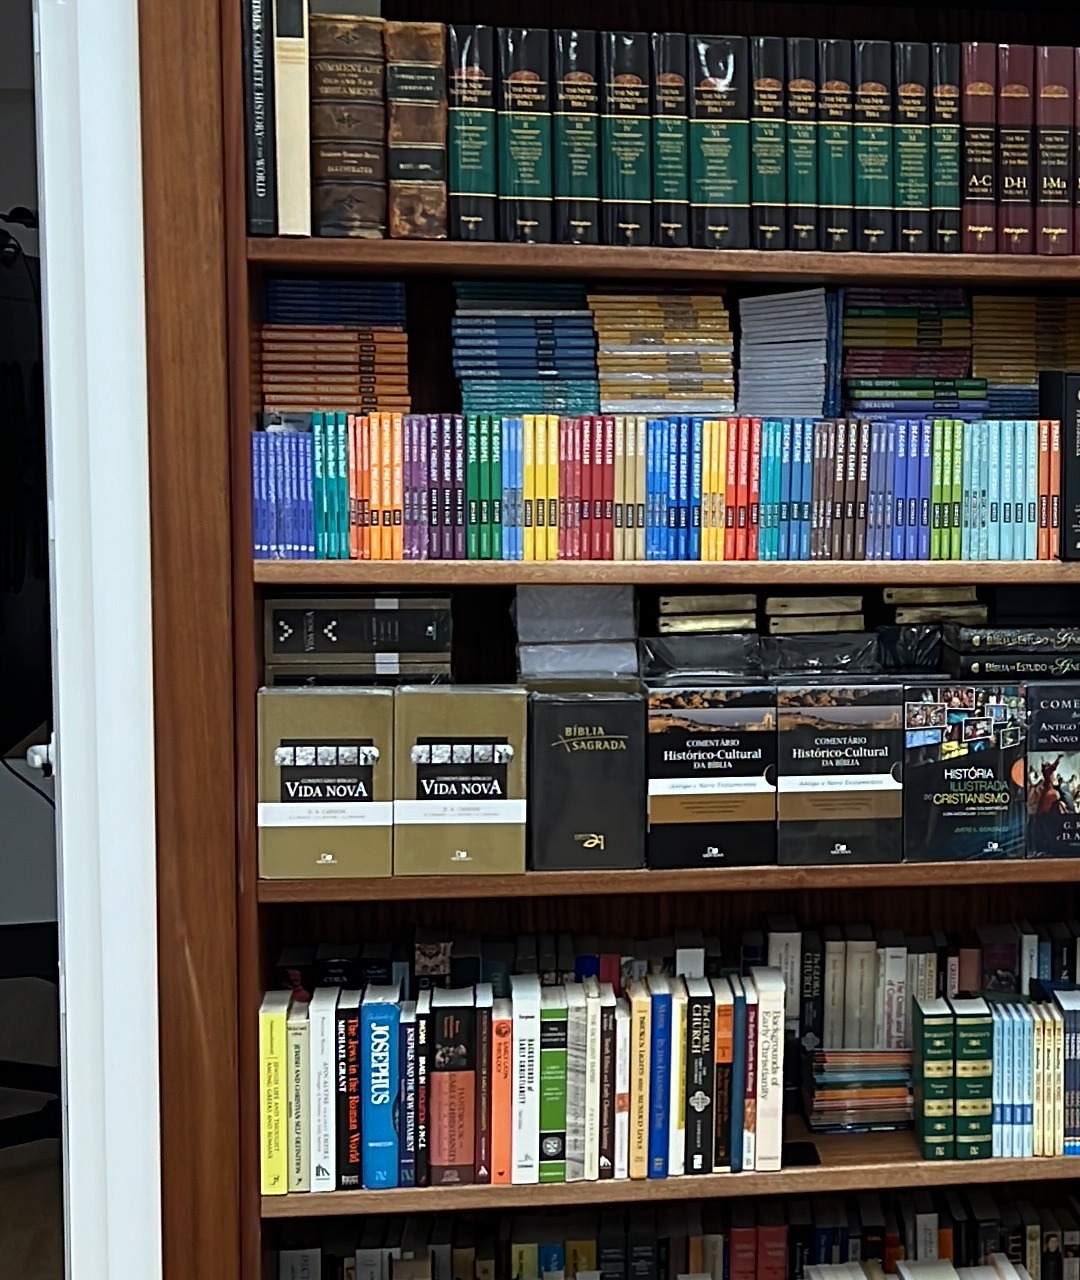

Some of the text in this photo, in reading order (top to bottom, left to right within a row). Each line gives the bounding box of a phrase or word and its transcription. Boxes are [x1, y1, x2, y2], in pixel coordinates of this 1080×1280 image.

[252, 35, 263, 86] COMPLETE
[254, 90, 264, 143] HISTORY
[256, 159, 266, 198] WORLD
[969, 175, 993, 186] A-C
[1005, 177, 1026, 188] D-H
[1043, 177, 1066, 188] I-Ma
[985, 663, 1009, 671] BÍBLIA
[1017, 662, 1047, 671] ESTUDO
[565, 726, 604, 737] BÍBLIA
[1040, 722, 1077, 731] ANTIGO
[572, 740, 626, 751] SAGRADA
[686, 738, 739, 747] COMENTÁRIO
[814, 736, 867, 745] COMENTÁRIO
[1050, 735, 1078, 744] NOVO
[663, 749, 761, 761] Histórico-Cultural
[792, 747, 888, 759] Histórico-Cultural
[693, 760, 732, 769] DA BÍBLIA
[822, 759, 860, 767] DA BÍBLIA
[944, 766, 994, 780] HISTÓRIA
[285, 782, 368, 797] VIDA NOVA
[421, 779, 501, 795] VIDA NOVA
[950, 781, 1008, 791] ILUSTRADA
[933, 792, 1010, 804] CRISTIANISMO
[1062, 832, 1072, 840] D.
[691, 1004, 701, 1054] CHURCH
[702, 1018, 710, 1054] GLOBAL
[770, 1011, 781, 1087] Backgrounds of
[337, 1020, 347, 1092] MICHAEL GRANT
[760, 1011, 770, 1100] Early Christianity
[370, 1023, 390, 1104] JOSEPHUS
[348, 1018, 360, 1163] The Jews in the Roman World
[405, 1027, 415, 1151] JOSEPHUS AND THE NEW TESTAMENT
